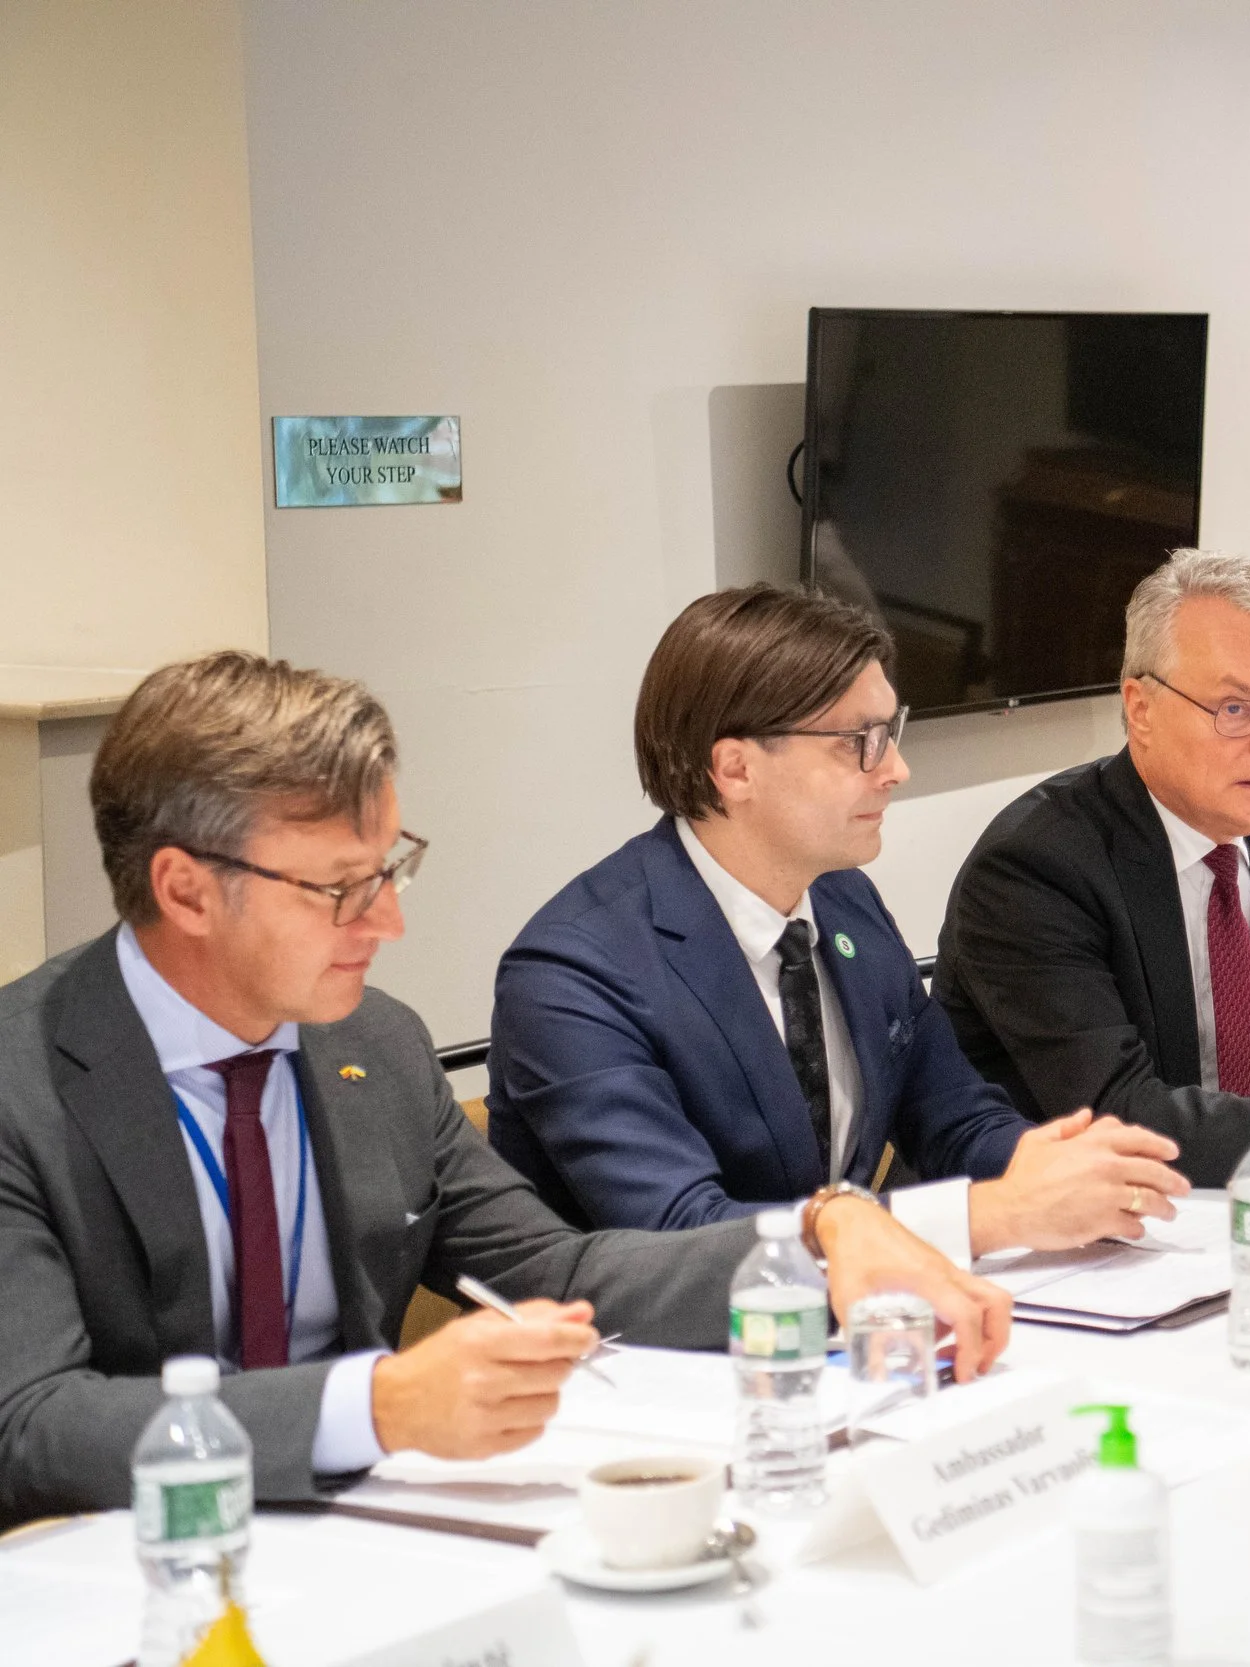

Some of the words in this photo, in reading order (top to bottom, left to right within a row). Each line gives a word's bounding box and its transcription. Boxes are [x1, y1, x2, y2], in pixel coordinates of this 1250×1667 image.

[309, 437, 370, 456] PLEASE
[374, 437, 429, 454] WATCH
[327, 467, 373, 484] YOUR
[377, 466, 415, 483] STEP
